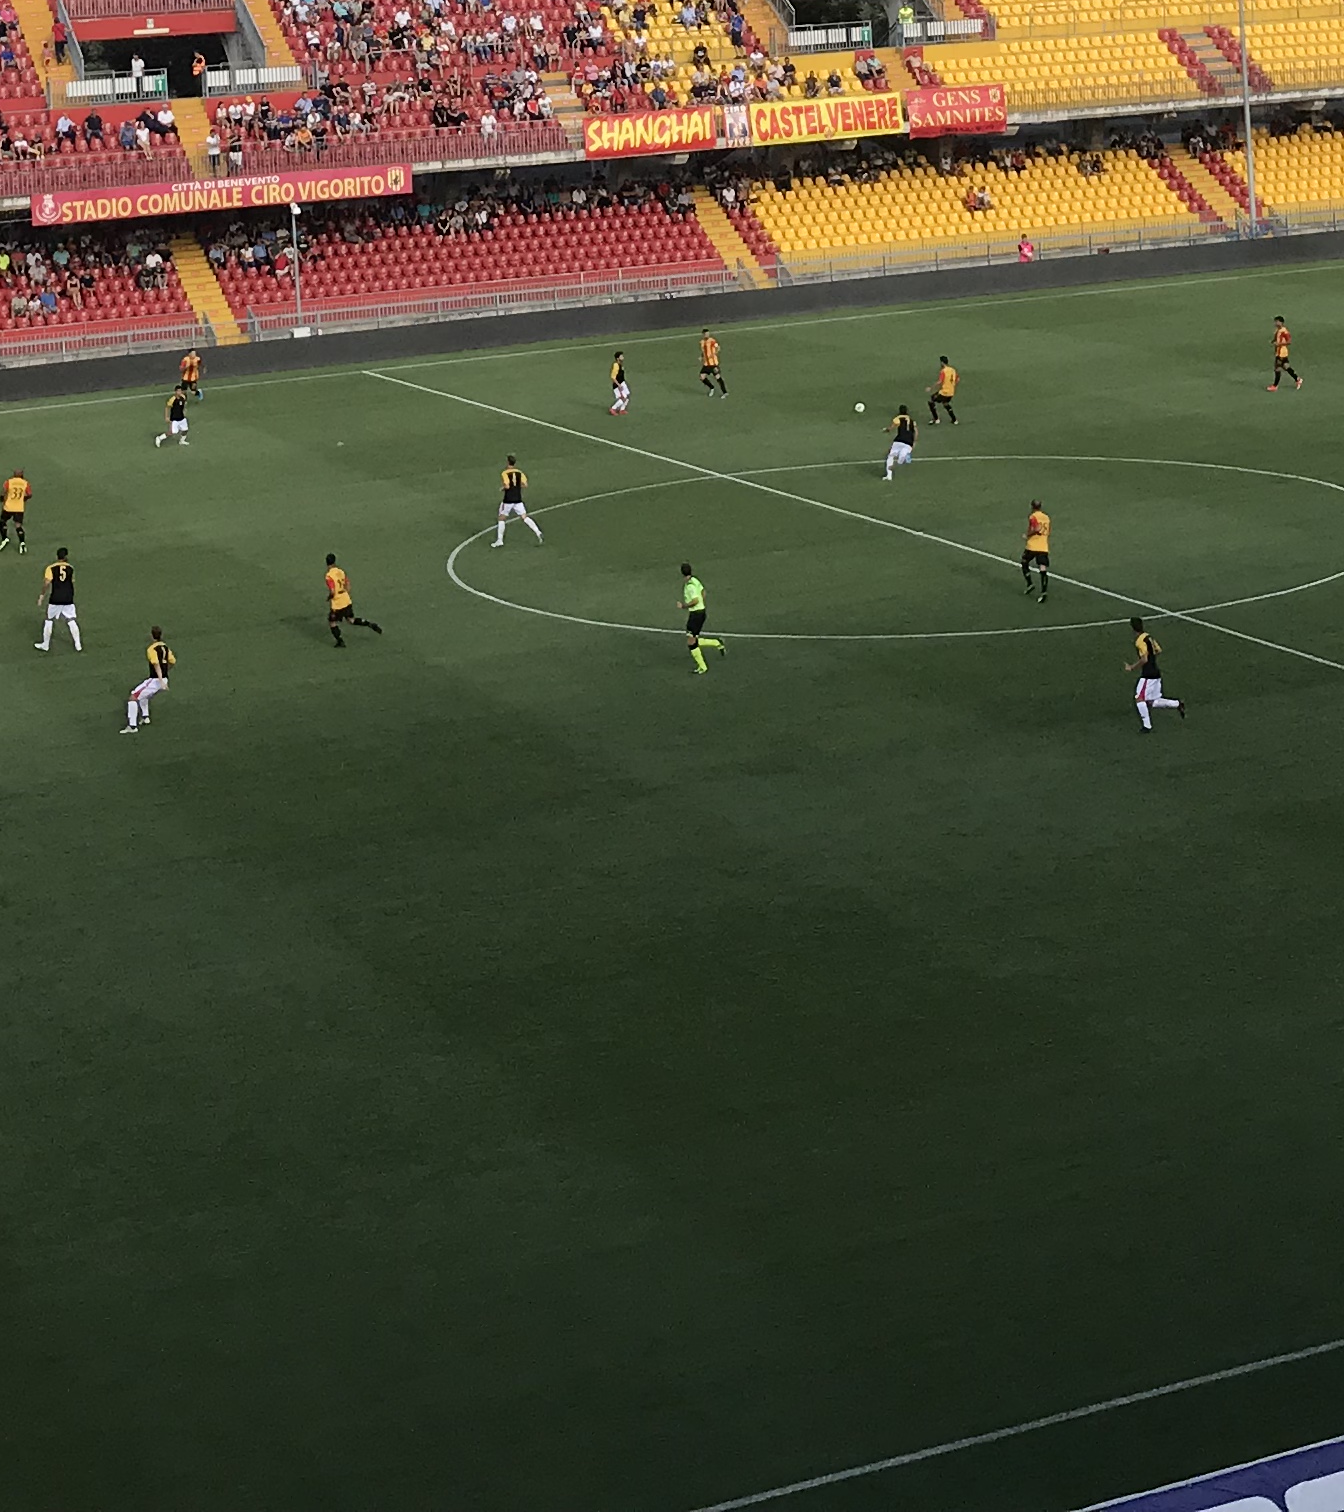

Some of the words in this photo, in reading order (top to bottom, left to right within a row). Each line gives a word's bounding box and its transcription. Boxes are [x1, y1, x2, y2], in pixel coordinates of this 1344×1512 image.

[932, 90, 981, 107] GENS
[911, 106, 1005, 128] SAMNITES
[587, 111, 711, 152] SHANGHAI
[171, 180, 201, 192] CITTÀ
[203, 180, 216, 190] DI
[217, 175, 280, 188] BENEVENTO
[62, 196, 132, 222] STADIO
[136, 187, 243, 215] COMUNALE
[250, 182, 295, 205] CIRO
[297, 175, 385, 201] VIGORITO
[10, 487, 24, 500] 33
[59, 565, 67, 582] 5
